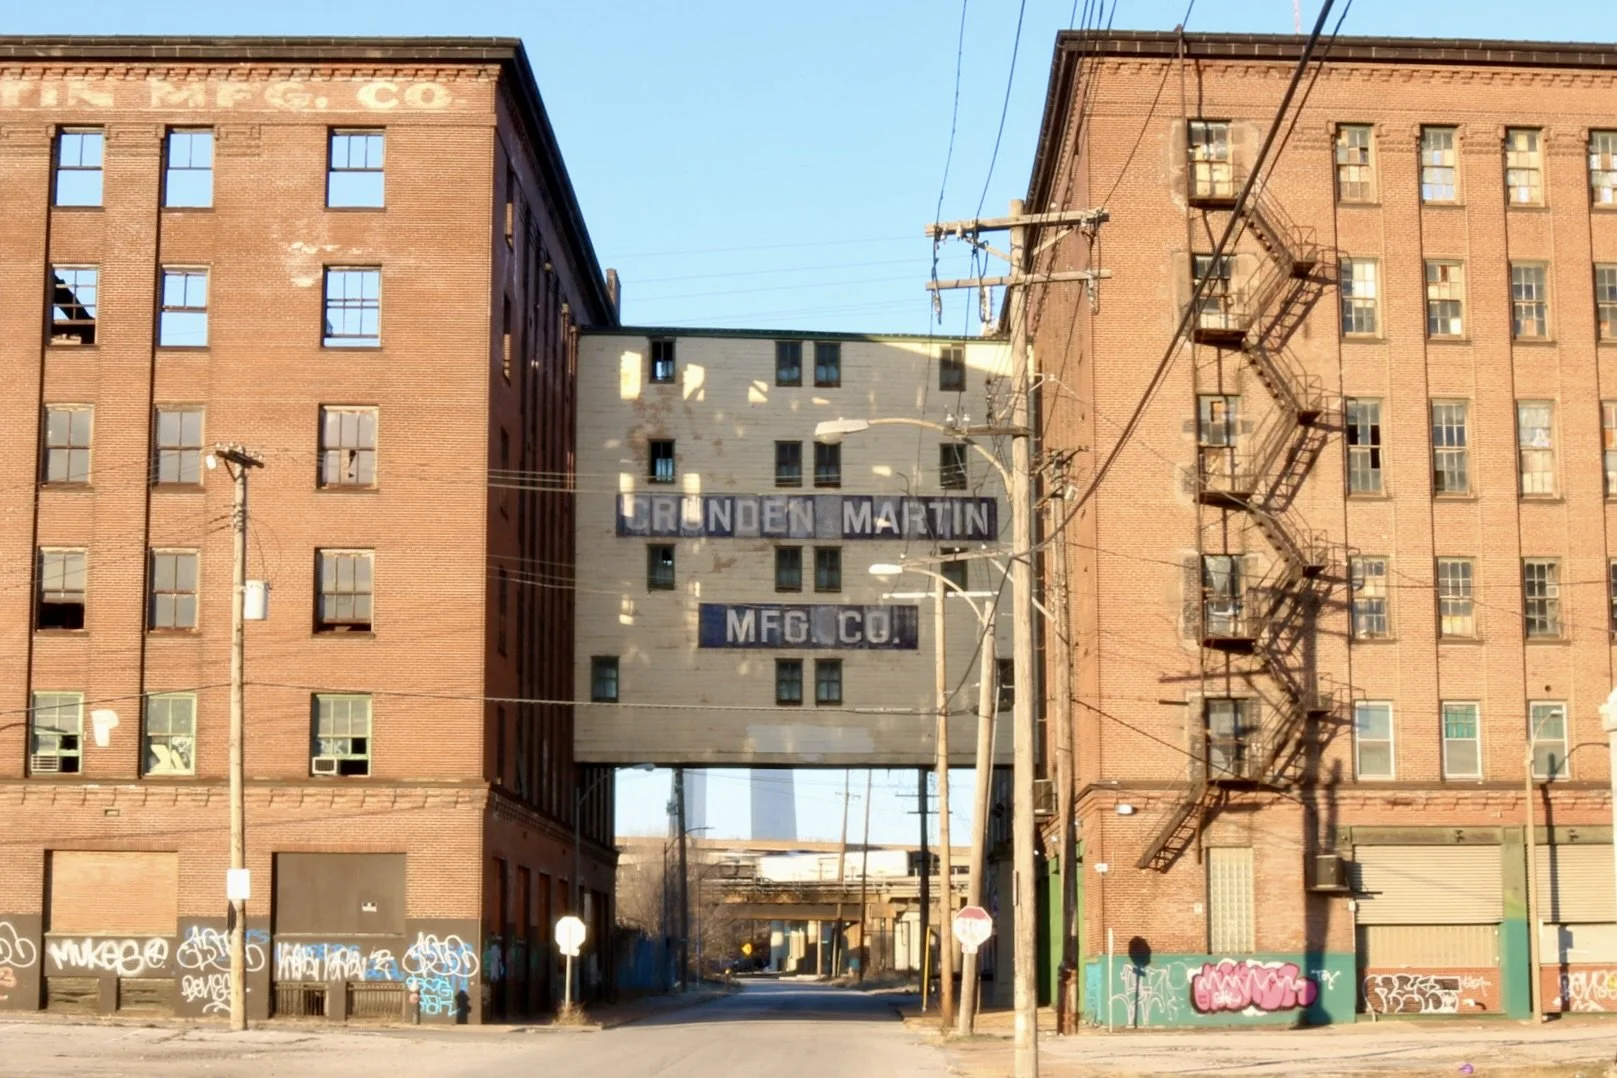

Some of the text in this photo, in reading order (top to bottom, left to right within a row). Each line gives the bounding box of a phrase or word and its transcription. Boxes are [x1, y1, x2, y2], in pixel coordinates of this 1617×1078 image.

[843, 502, 988, 535] MARTIN
[726, 609, 900, 645] MFG. CO.
